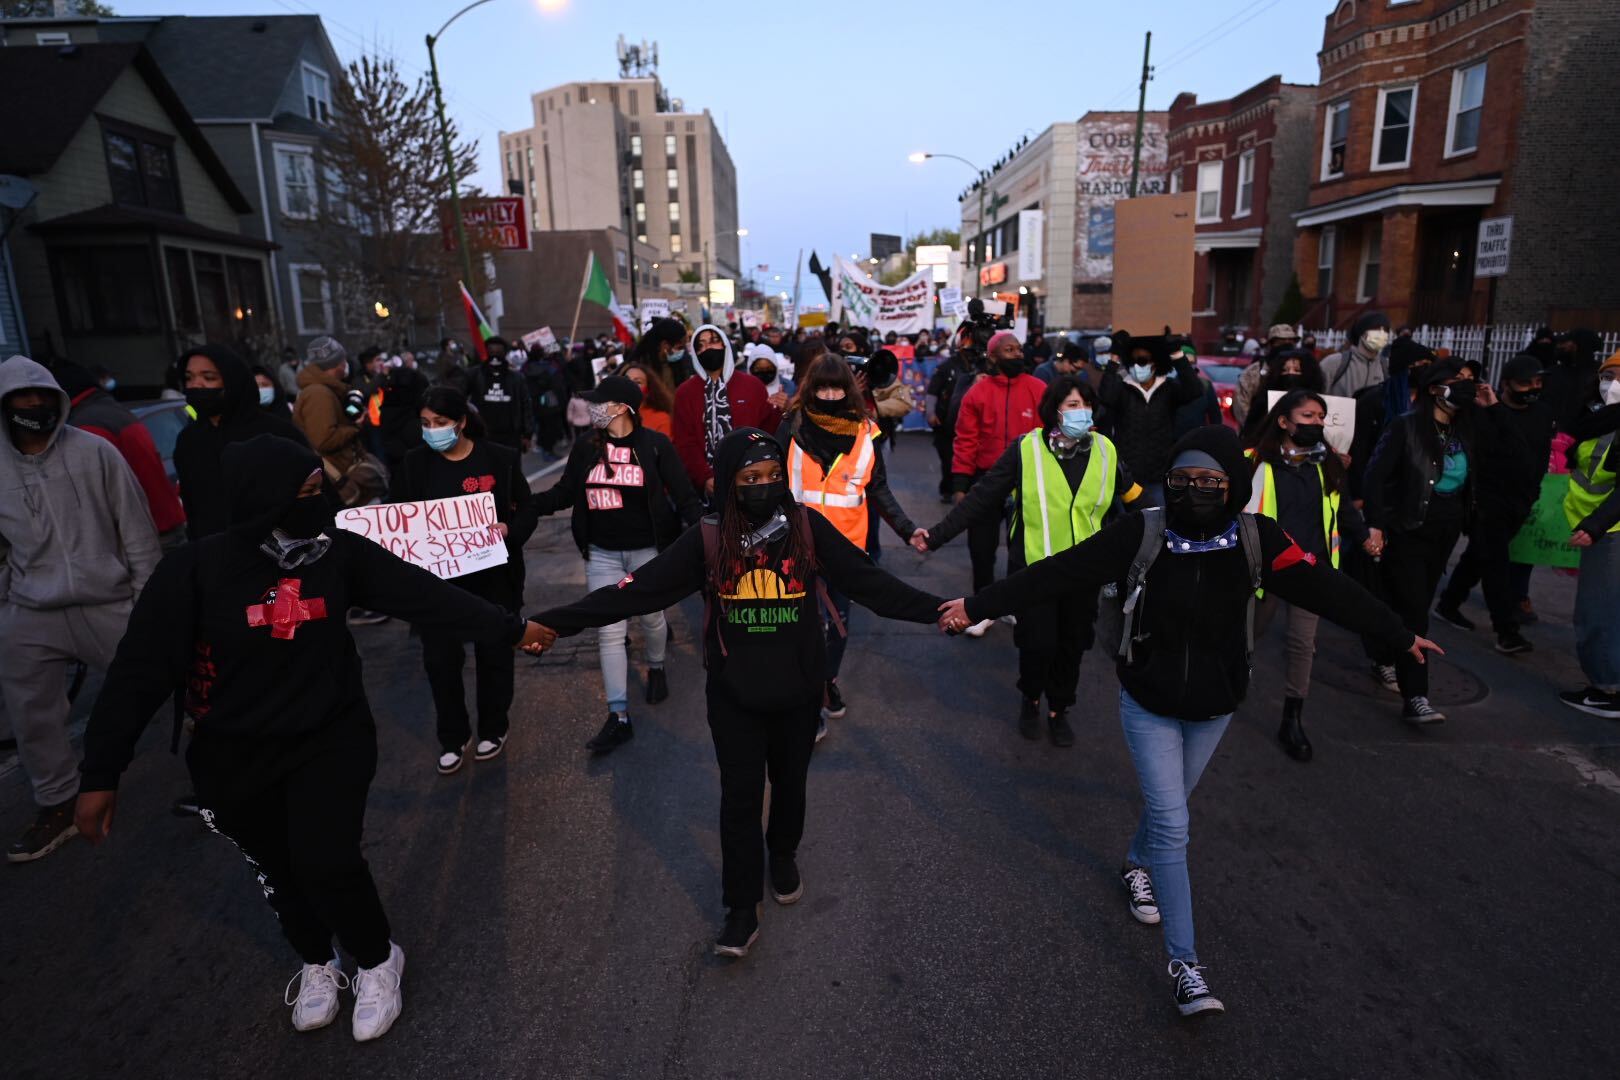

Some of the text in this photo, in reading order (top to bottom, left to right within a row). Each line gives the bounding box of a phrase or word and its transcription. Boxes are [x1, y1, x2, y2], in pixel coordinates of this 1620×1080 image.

[1089, 132, 1159, 149] COBY
[1487, 224, 1504, 236] THRU
[1480, 239, 1507, 253] TRAFFIC
[588, 489, 620, 510] GIRL
[345, 495, 496, 537] STOP KILLING
[759, 606, 800, 624] RISING
